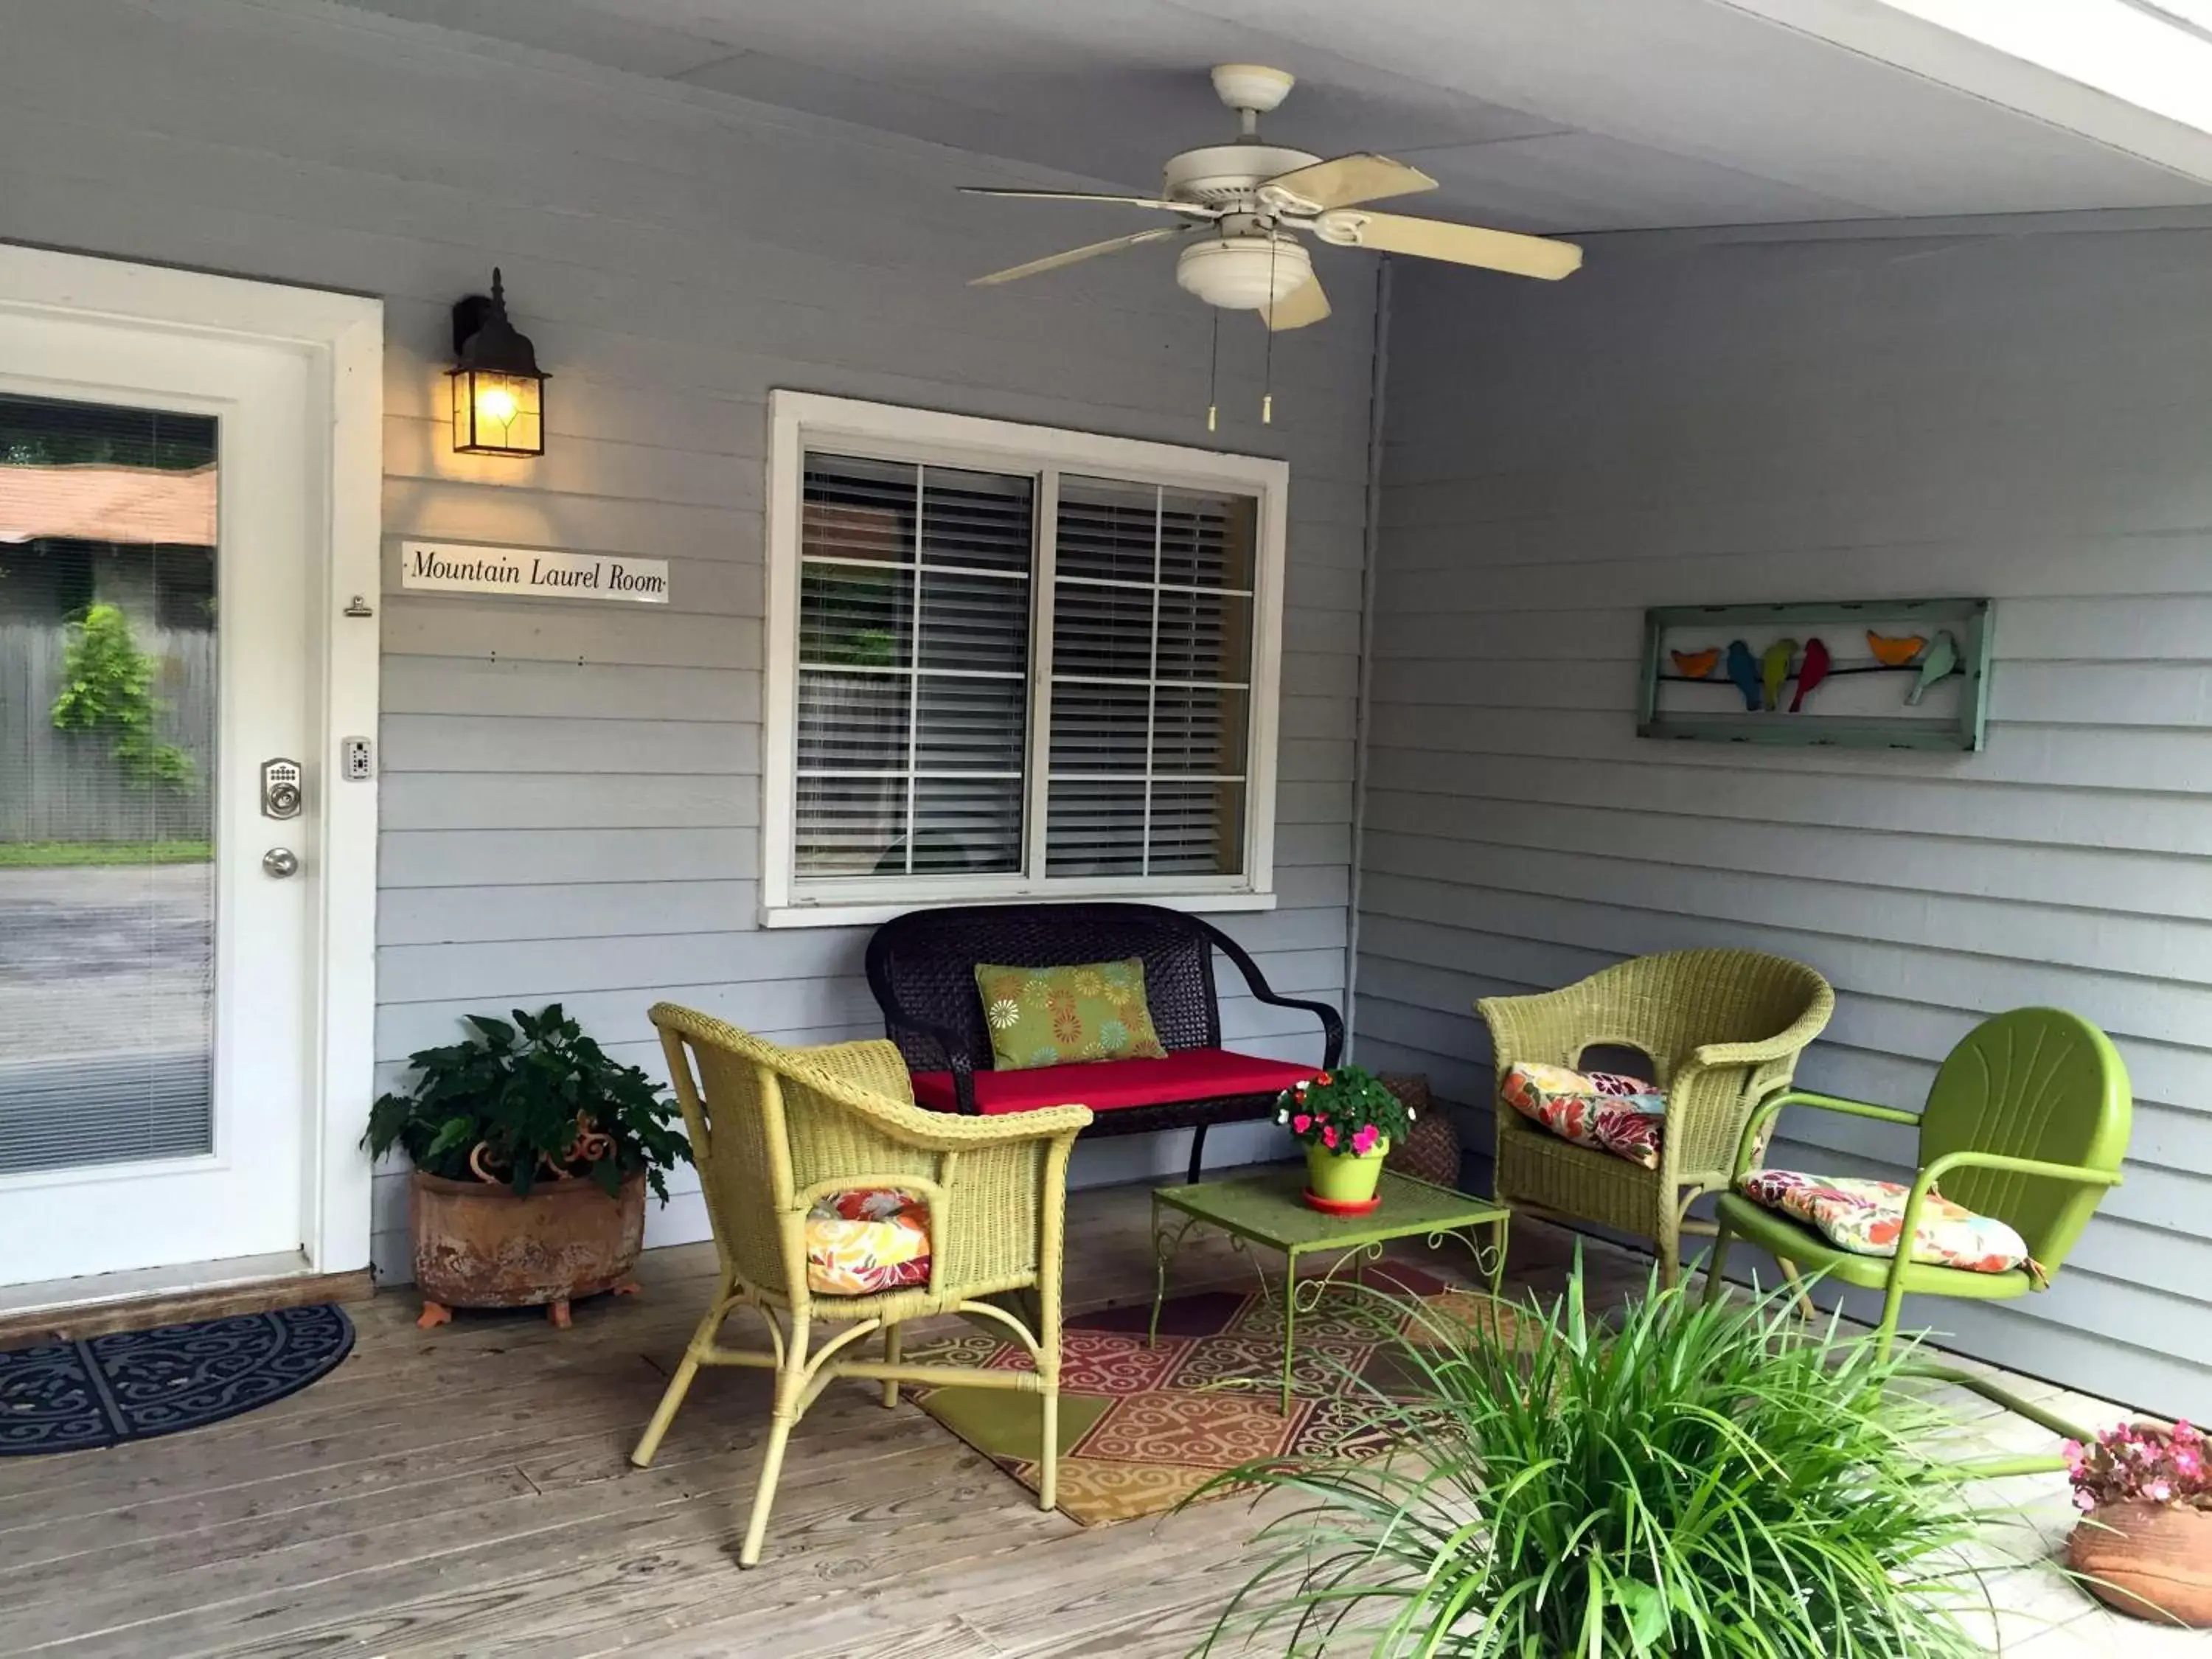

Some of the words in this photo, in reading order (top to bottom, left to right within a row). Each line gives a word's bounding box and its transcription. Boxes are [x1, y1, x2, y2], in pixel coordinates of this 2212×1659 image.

[411, 550, 520, 583] Mountain
[530, 558, 600, 589] Laurel
[608, 564, 663, 593] Room
